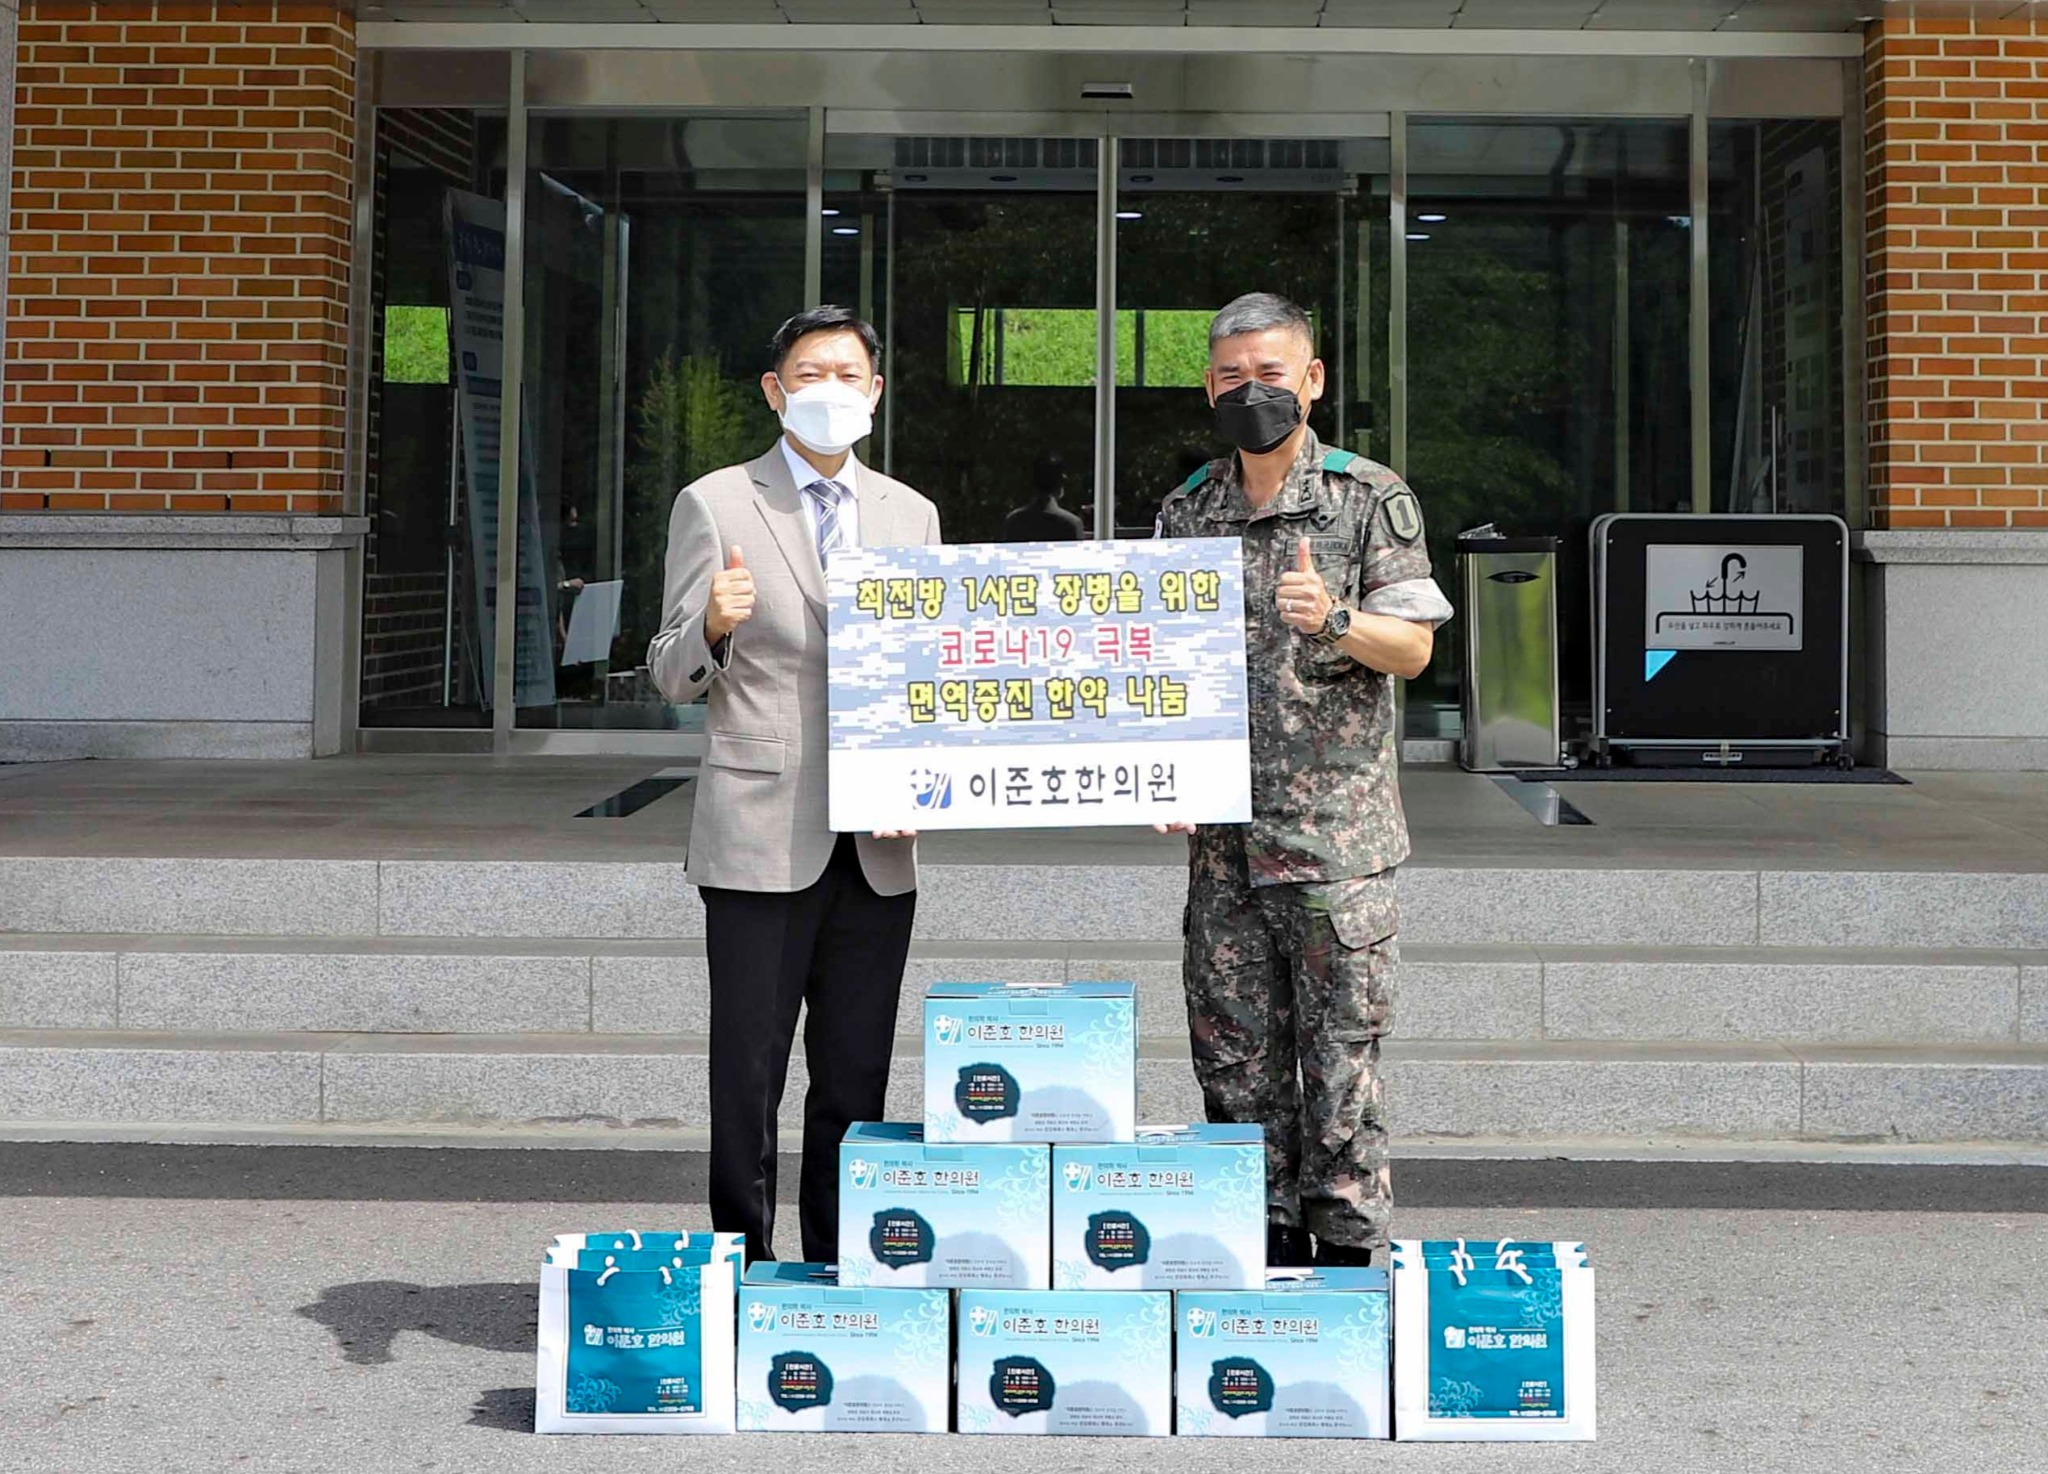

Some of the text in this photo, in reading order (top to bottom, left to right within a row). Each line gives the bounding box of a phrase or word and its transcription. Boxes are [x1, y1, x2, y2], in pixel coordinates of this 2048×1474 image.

[857, 570, 1220, 619] 최전방 1사단 장병을 위한
[941, 625, 1152, 666] 코로나19 극복
[907, 675, 1188, 723] 면역증진 한약 나눔
[969, 763, 1177, 807] 이준호한의원
[968, 1024, 1064, 1040] 이준호 한의원
[883, 1170, 980, 1186] 이준호 한의원
[1097, 1172, 1194, 1188] 이준호 한의원
[781, 1314, 877, 1330] 이준호 한의원
[1003, 1318, 1099, 1334] 이준호 한의원
[1222, 1319, 1318, 1335] 이준호 한의원
[606, 1331, 685, 1348] 이준호 한의원
[1468, 1334, 1548, 1349] 이준호 한의원
